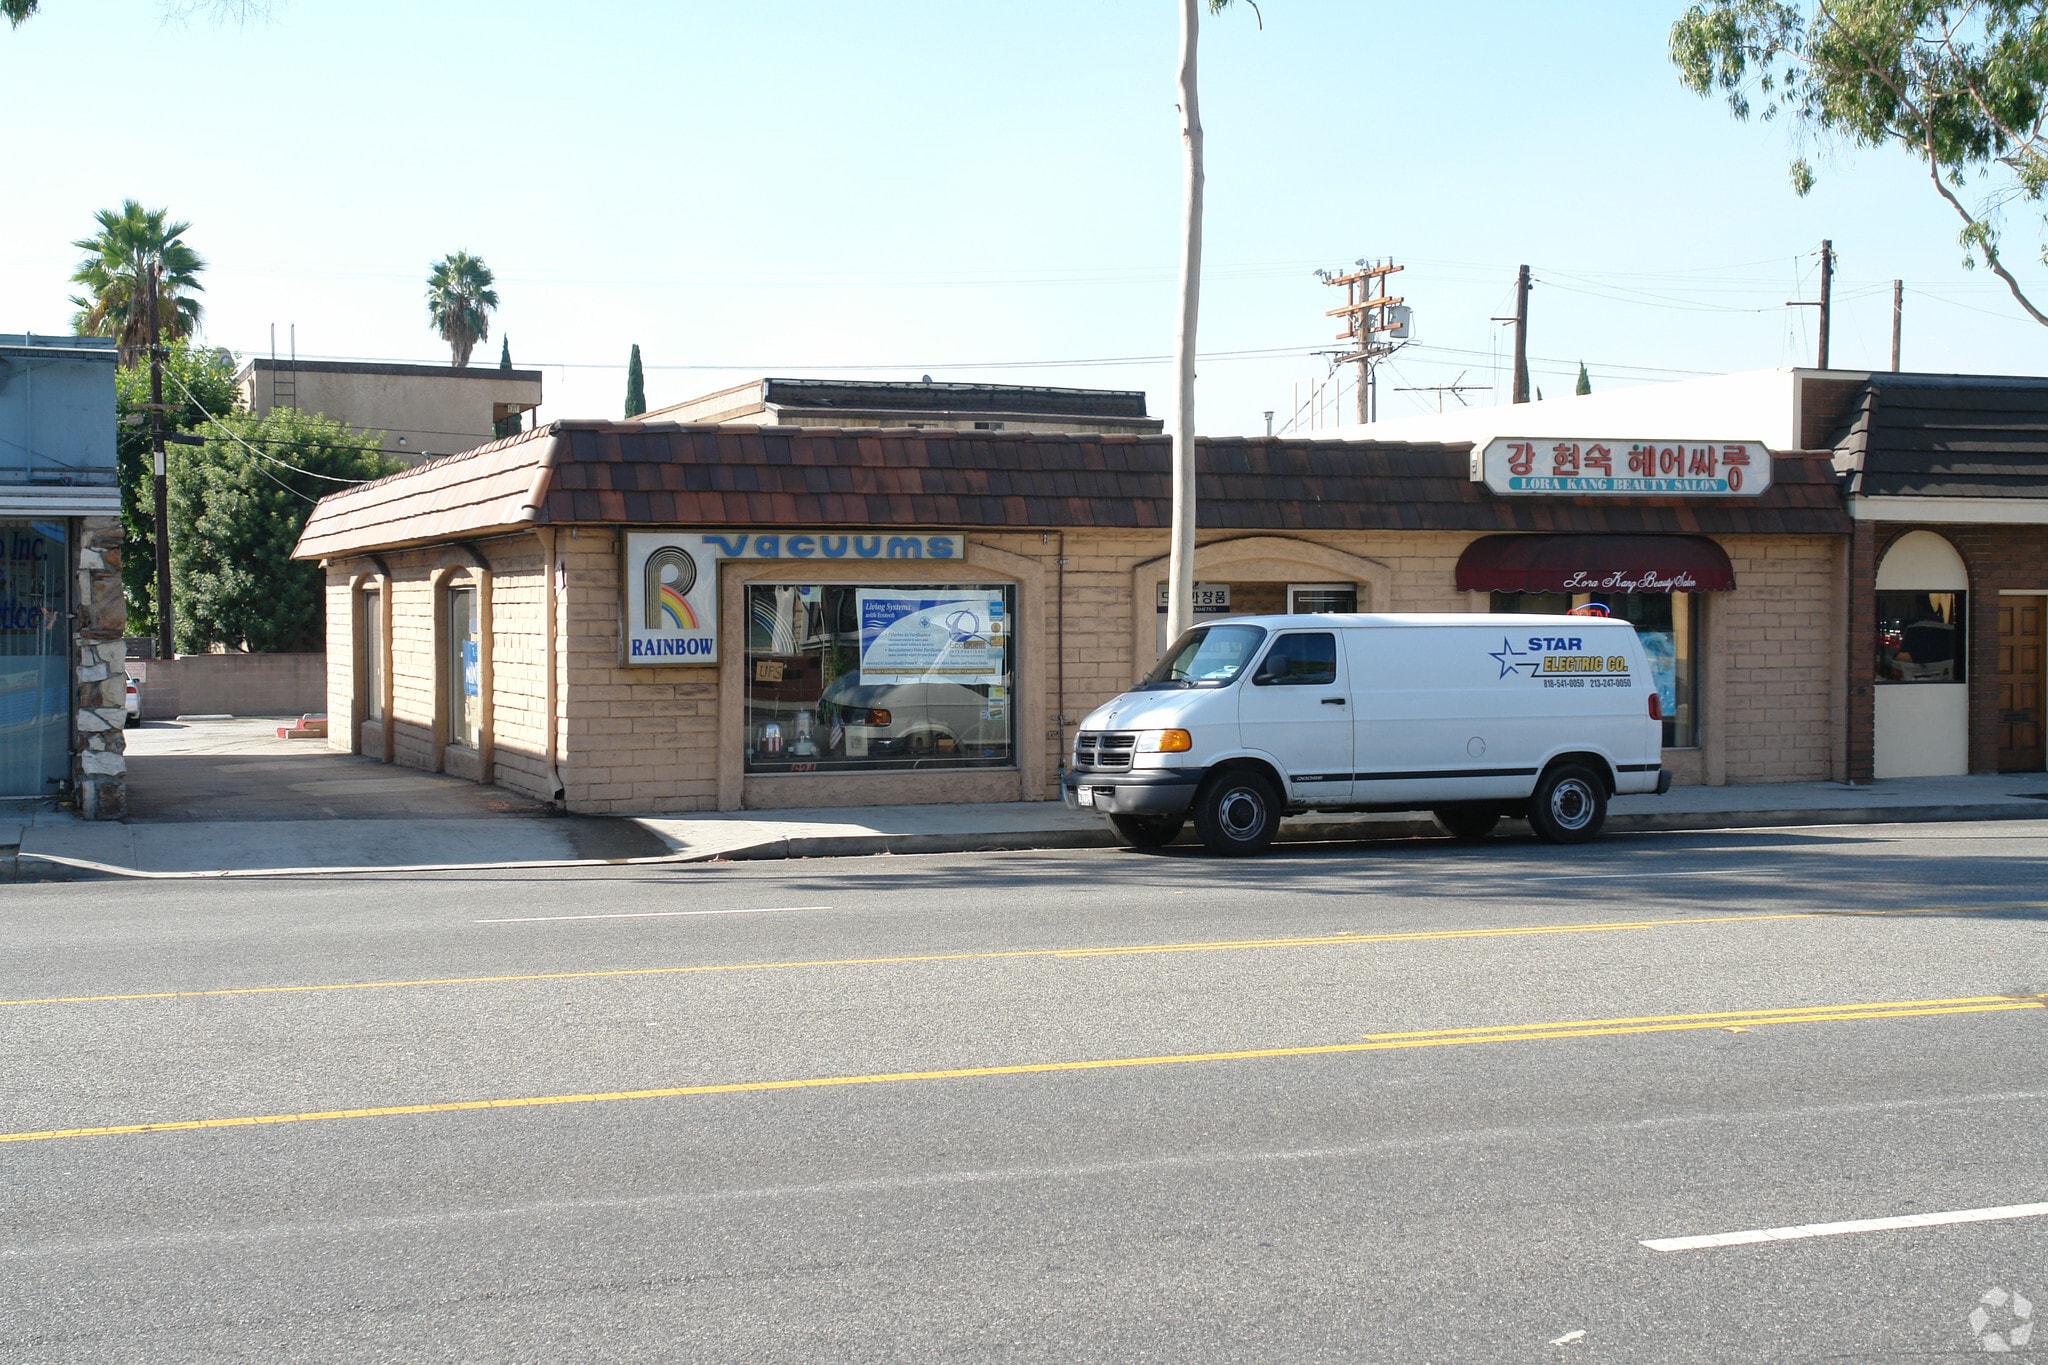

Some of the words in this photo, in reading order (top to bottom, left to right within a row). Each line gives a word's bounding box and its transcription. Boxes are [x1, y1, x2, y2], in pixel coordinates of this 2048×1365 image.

[1521, 477, 1560, 490] LORA
[1567, 477, 1608, 490] KANG
[1613, 478, 1669, 490] BEAUTY
[1674, 478, 1719, 491] SALON
[11, 531, 48, 561] Inc.
[1563, 571, 1599, 588] Lora
[1602, 571, 1637, 594] Kang
[0, 598, 40, 630] tice
[865, 602, 885, 612] Living
[886, 602, 911, 613] Systems
[631, 637, 713, 657] RAINBOW
[1528, 637, 1582, 651] STAR
[759, 664, 782, 679] UPS
[1543, 655, 1602, 672] ELECTRIC
[1606, 655, 1629, 672] CO.
[1543, 679, 1585, 688] 818-541-0050
[1590, 679, 1632, 688] 213-247-0050
